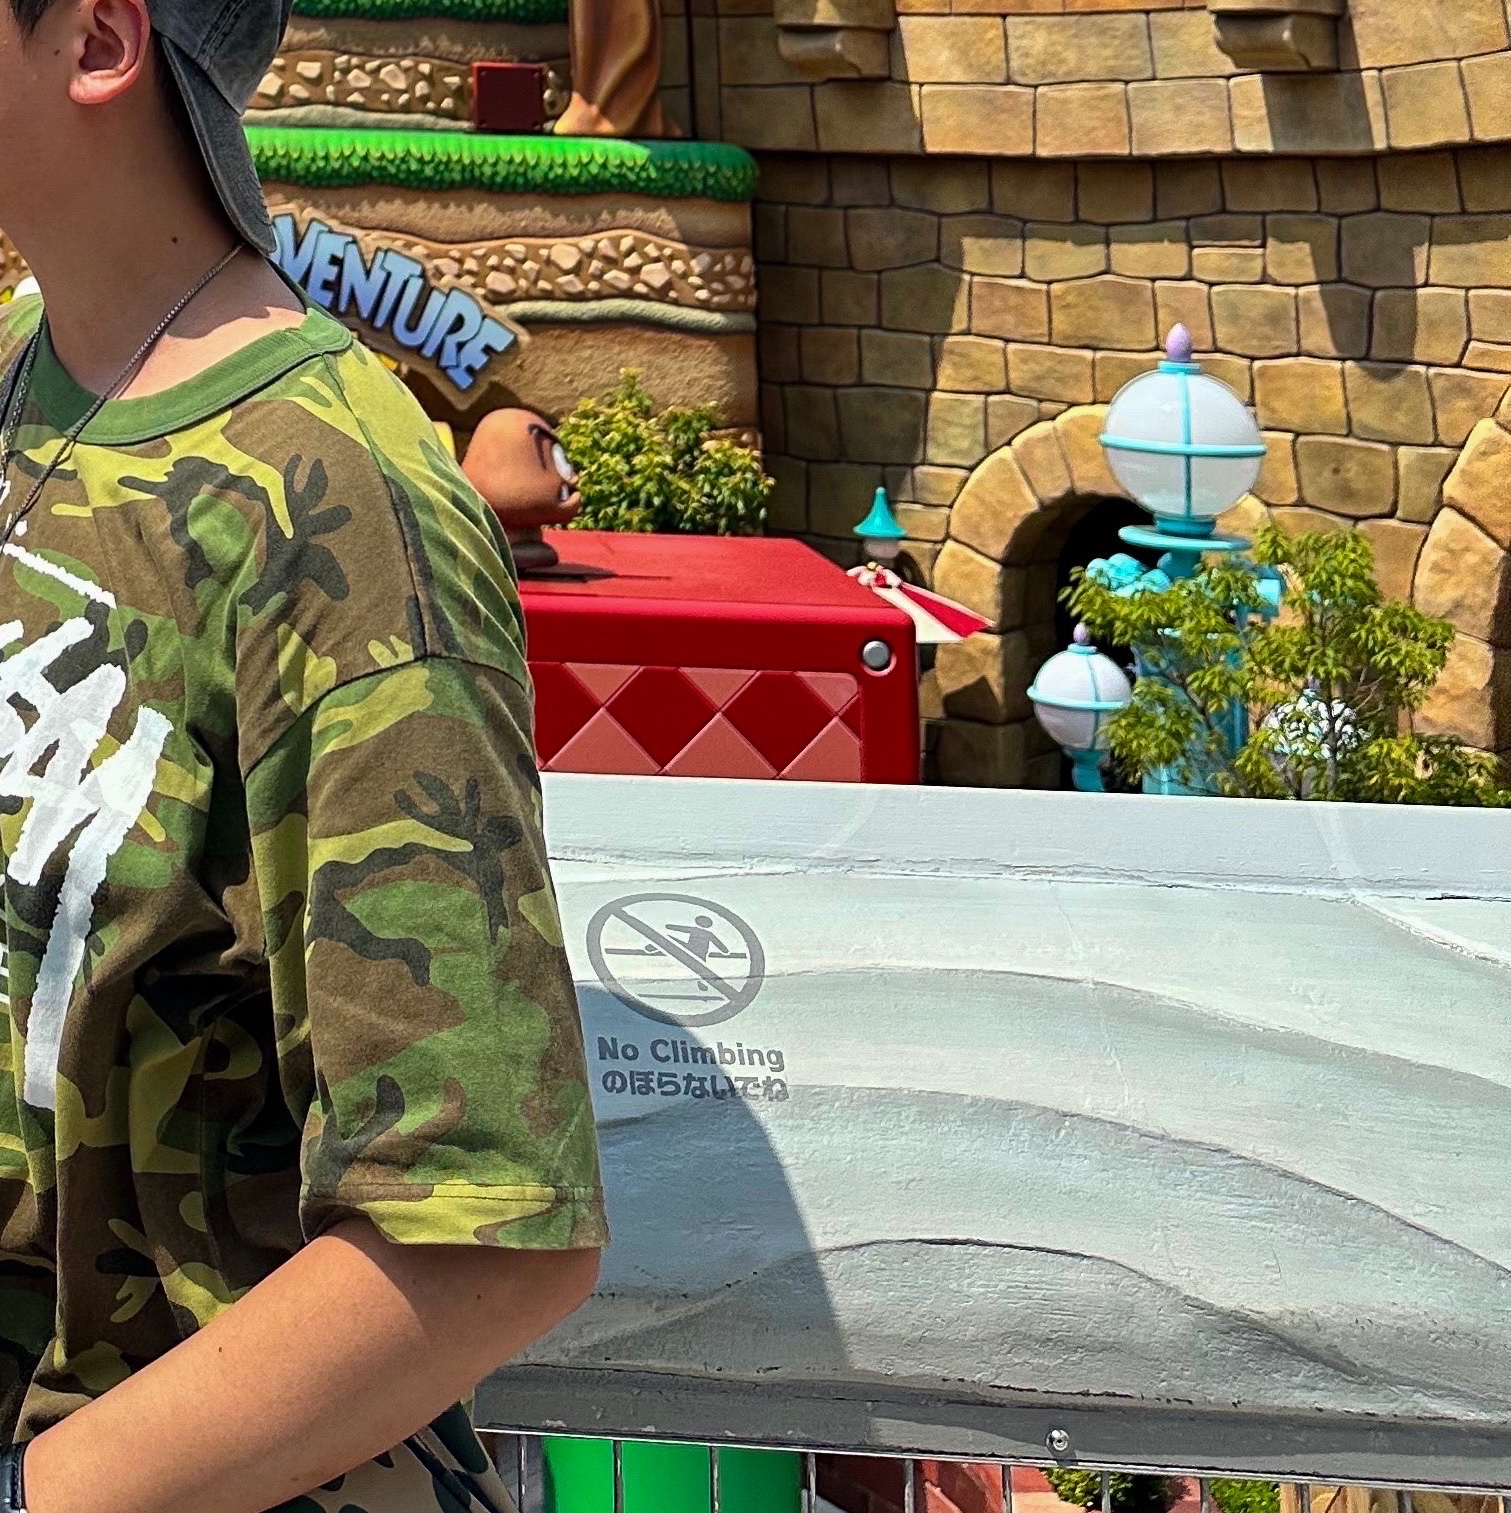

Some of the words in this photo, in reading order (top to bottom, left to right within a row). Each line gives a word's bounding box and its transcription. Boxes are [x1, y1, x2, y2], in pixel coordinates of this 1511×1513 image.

[271, 213, 517, 389] VENTURE
[597, 1036, 639, 1061] No
[650, 1039, 785, 1072] Climbing
[601, 1070, 790, 1102] のぼらないでね
